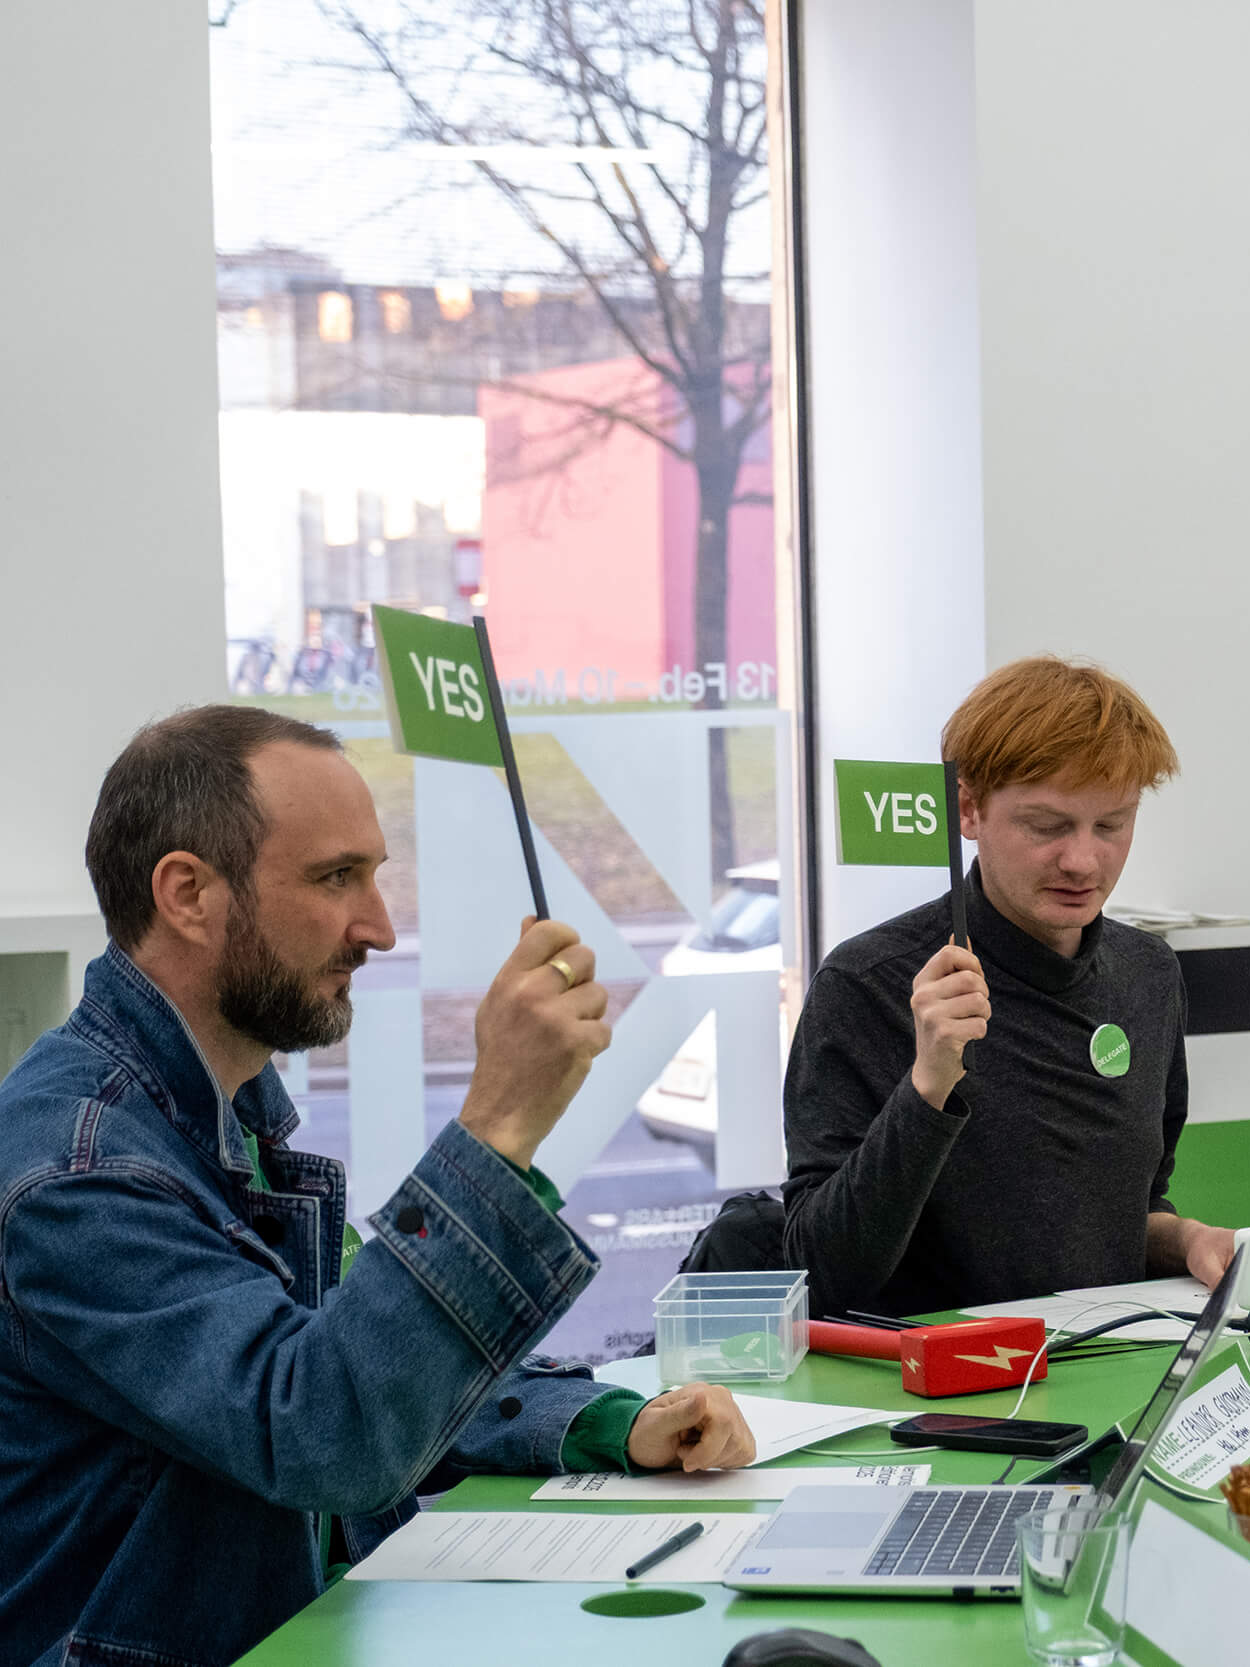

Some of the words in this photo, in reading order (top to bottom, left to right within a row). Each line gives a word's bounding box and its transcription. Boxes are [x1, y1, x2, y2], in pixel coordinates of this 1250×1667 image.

[408, 651, 484, 722] YES
[863, 791, 937, 834] YES
[1096, 1042, 1128, 1068] DELEGATE
